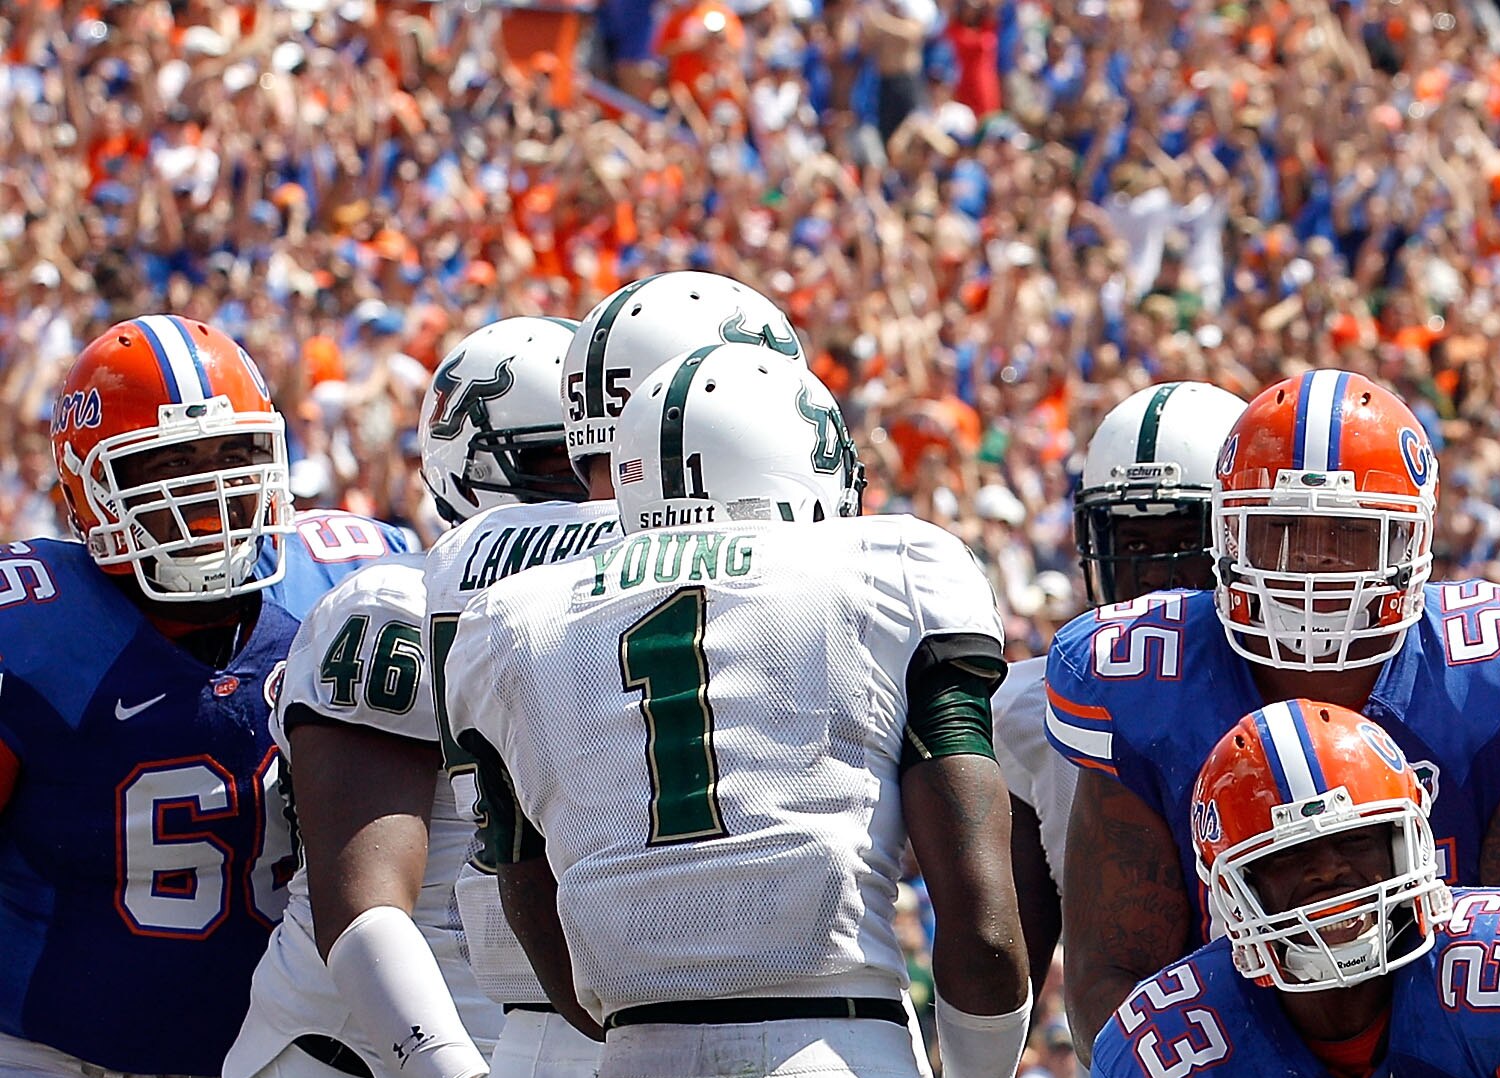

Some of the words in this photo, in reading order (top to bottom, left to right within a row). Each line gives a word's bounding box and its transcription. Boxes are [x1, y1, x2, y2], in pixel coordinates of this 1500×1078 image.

[567, 367, 631, 422] 55
[686, 452, 709, 500] 1
[1127, 467, 1162, 477] schutt
[639, 504, 715, 529] schutt
[591, 534, 757, 597] YOUNG
[320, 613, 426, 716] 46
[1091, 591, 1187, 682] 55
[617, 585, 731, 849] 1
